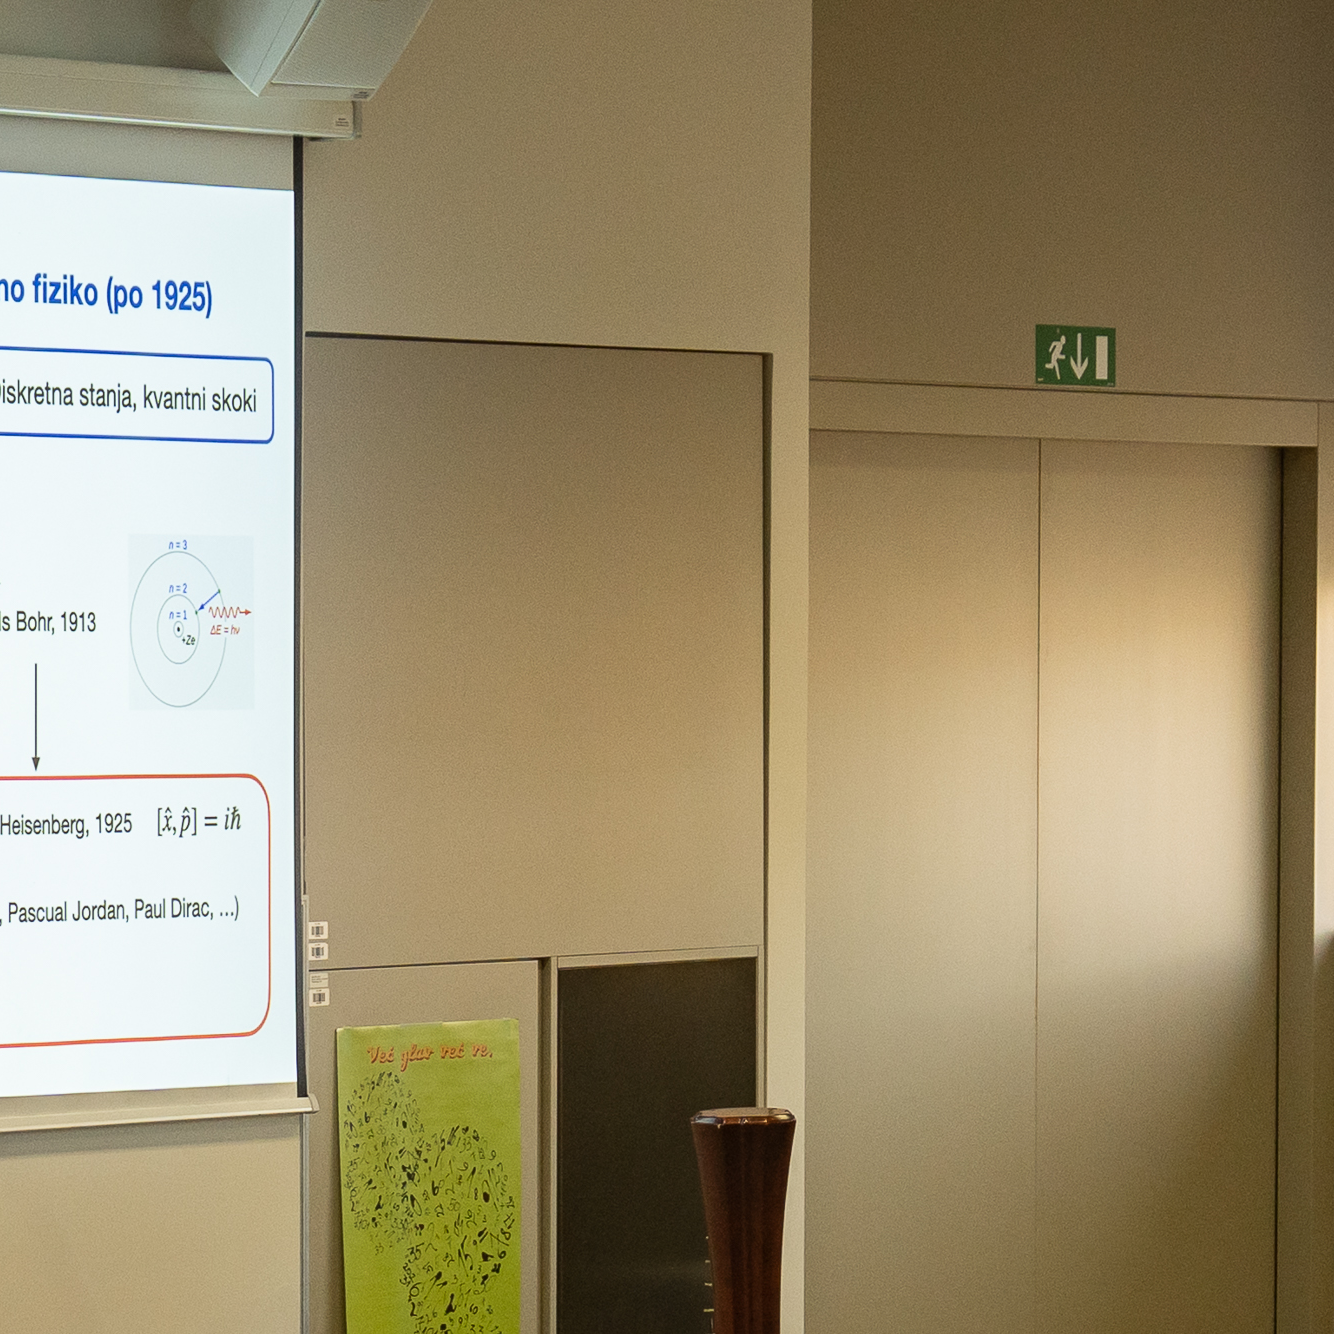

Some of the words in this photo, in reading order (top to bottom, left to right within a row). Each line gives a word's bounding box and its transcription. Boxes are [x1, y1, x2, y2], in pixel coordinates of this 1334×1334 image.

[32, 273, 98, 306] fiziko
[107, 276, 143, 314] (po
[152, 280, 212, 319] 1925)
[80, 383, 136, 413] stanja,
[144, 384, 205, 410] kvantni
[212, 387, 256, 412] skoki
[17, 611, 54, 635] Bohr,
[61, 612, 96, 632] 1913
[0, 814, 89, 839] Heisenberg,
[96, 813, 132, 833] 1925
[9, 901, 67, 923] Pascual
[72, 900, 128, 922] Jordan,
[135, 899, 165, 919] Paul
[171, 898, 213, 920] Dirac,
